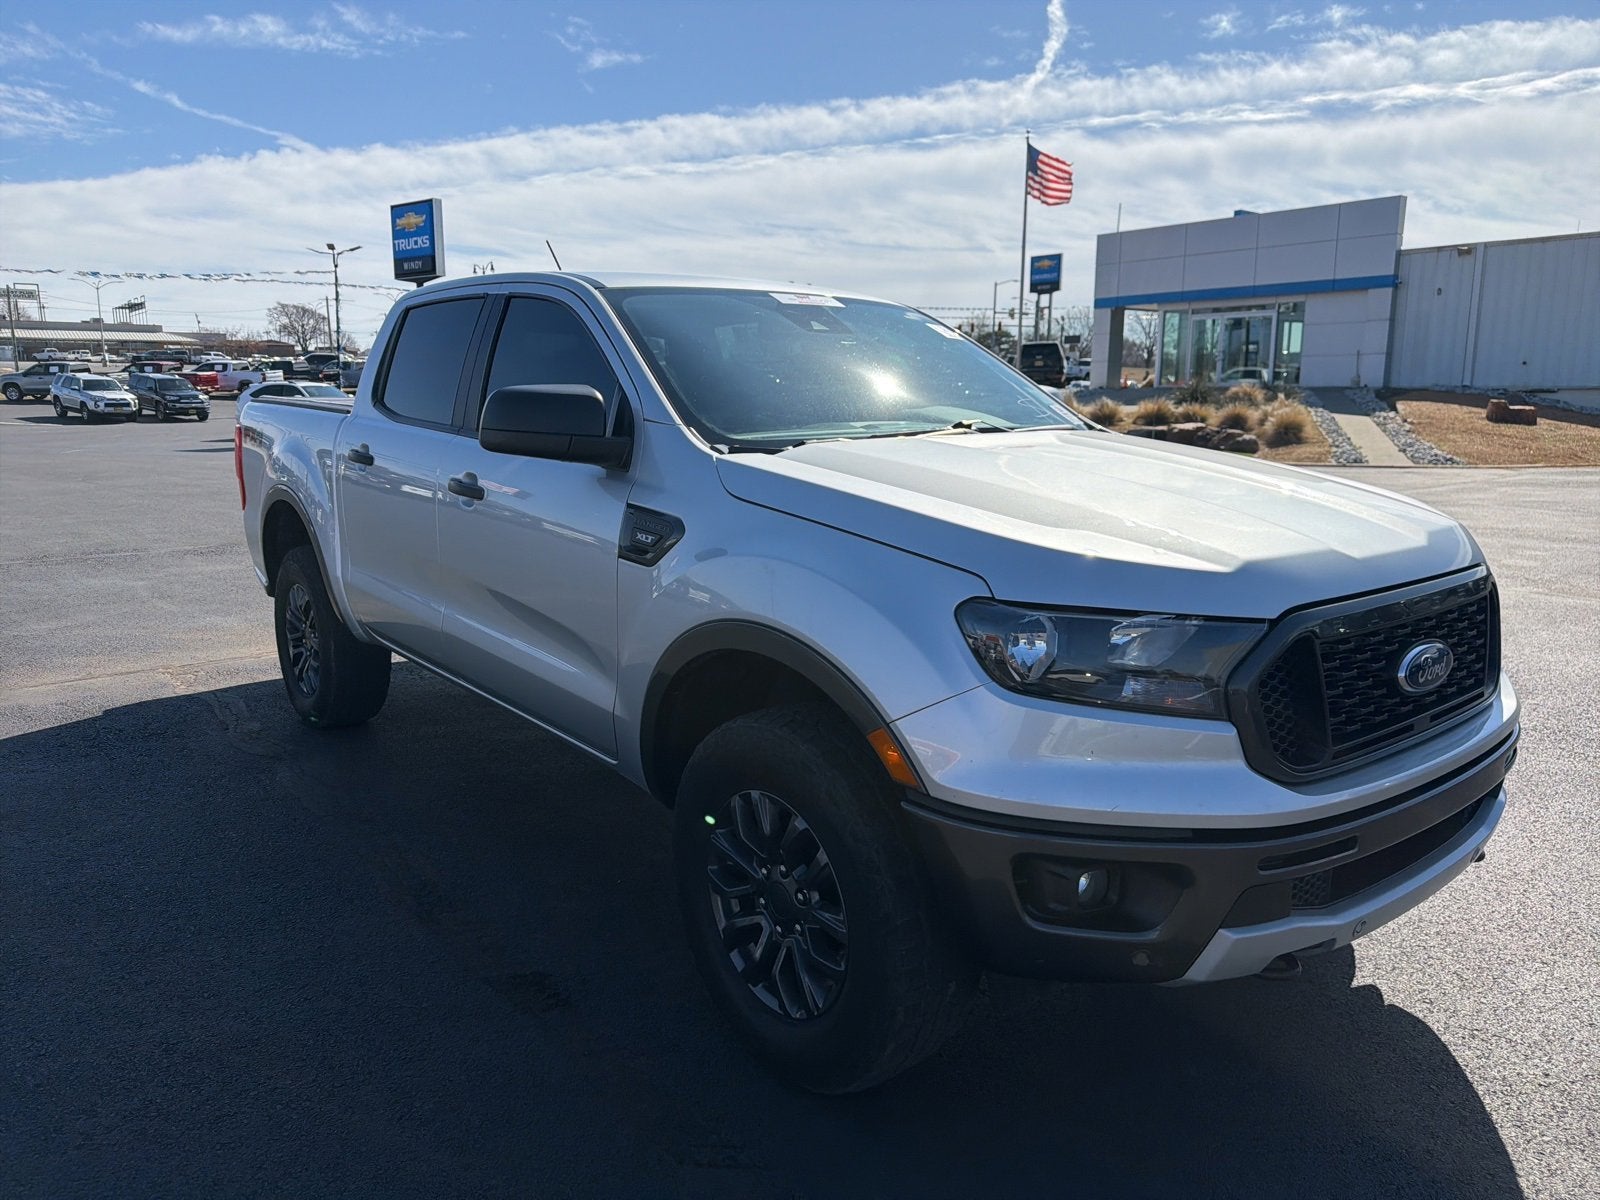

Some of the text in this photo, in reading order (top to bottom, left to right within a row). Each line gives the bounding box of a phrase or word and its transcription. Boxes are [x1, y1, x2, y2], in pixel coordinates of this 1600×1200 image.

[394, 235, 430, 251] TRUCKS
[403, 260, 423, 270] WINDY
[635, 532, 655, 543] XLT
[1418, 651, 1447, 683] Ford
